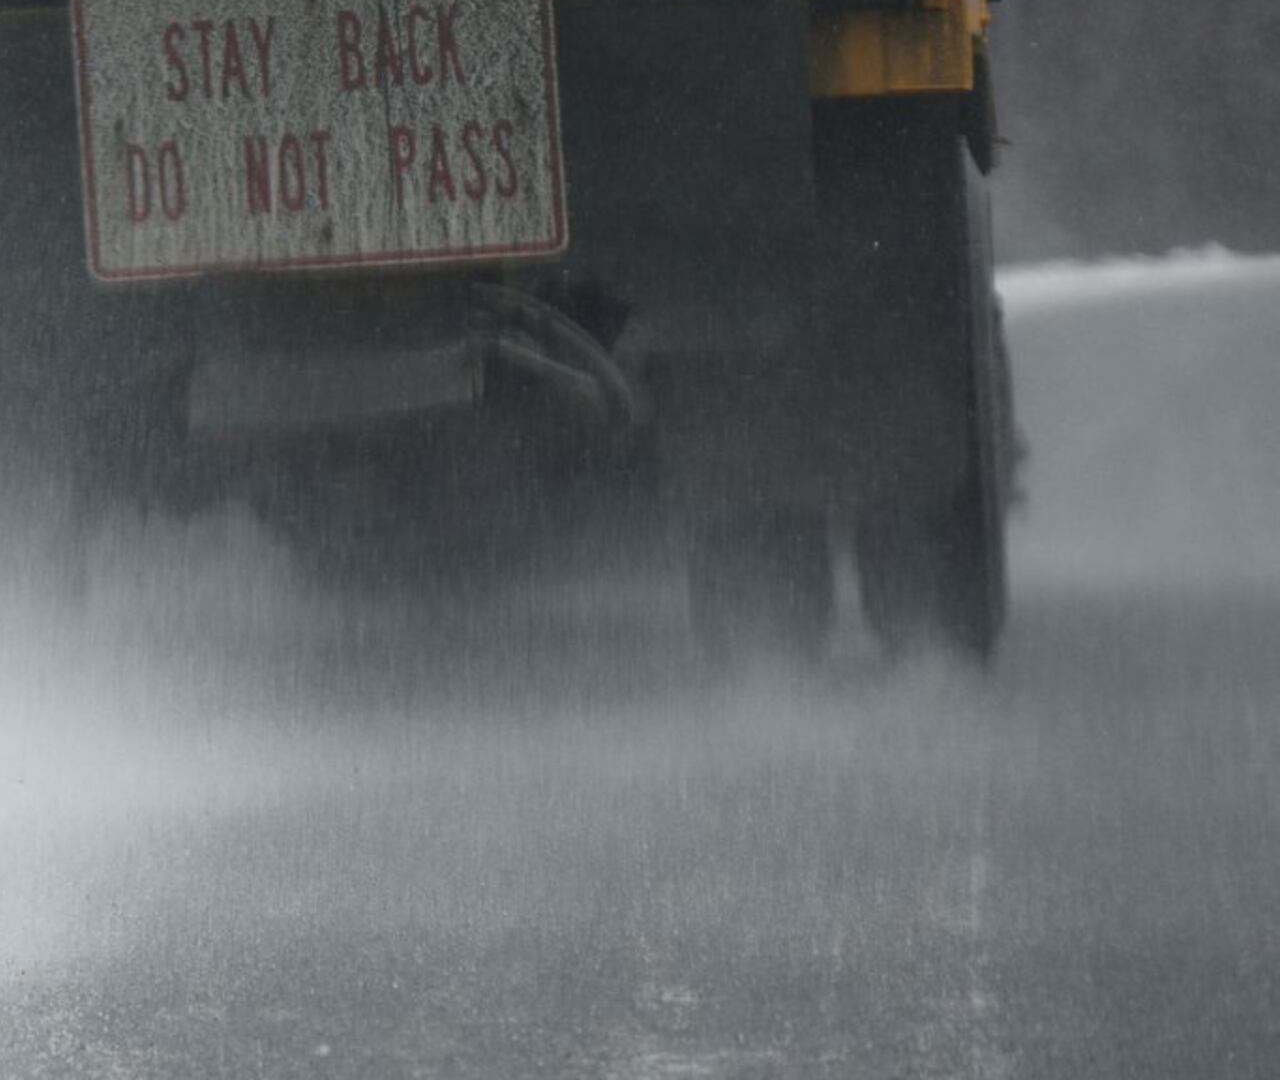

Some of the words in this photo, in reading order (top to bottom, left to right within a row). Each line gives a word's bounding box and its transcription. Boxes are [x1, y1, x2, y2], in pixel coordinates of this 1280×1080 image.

[163, 17, 274, 101] STAY
[340, 0, 466, 91] BACK
[126, 139, 185, 223] DO
[243, 130, 331, 213] NOT
[390, 120, 519, 211] PASS
